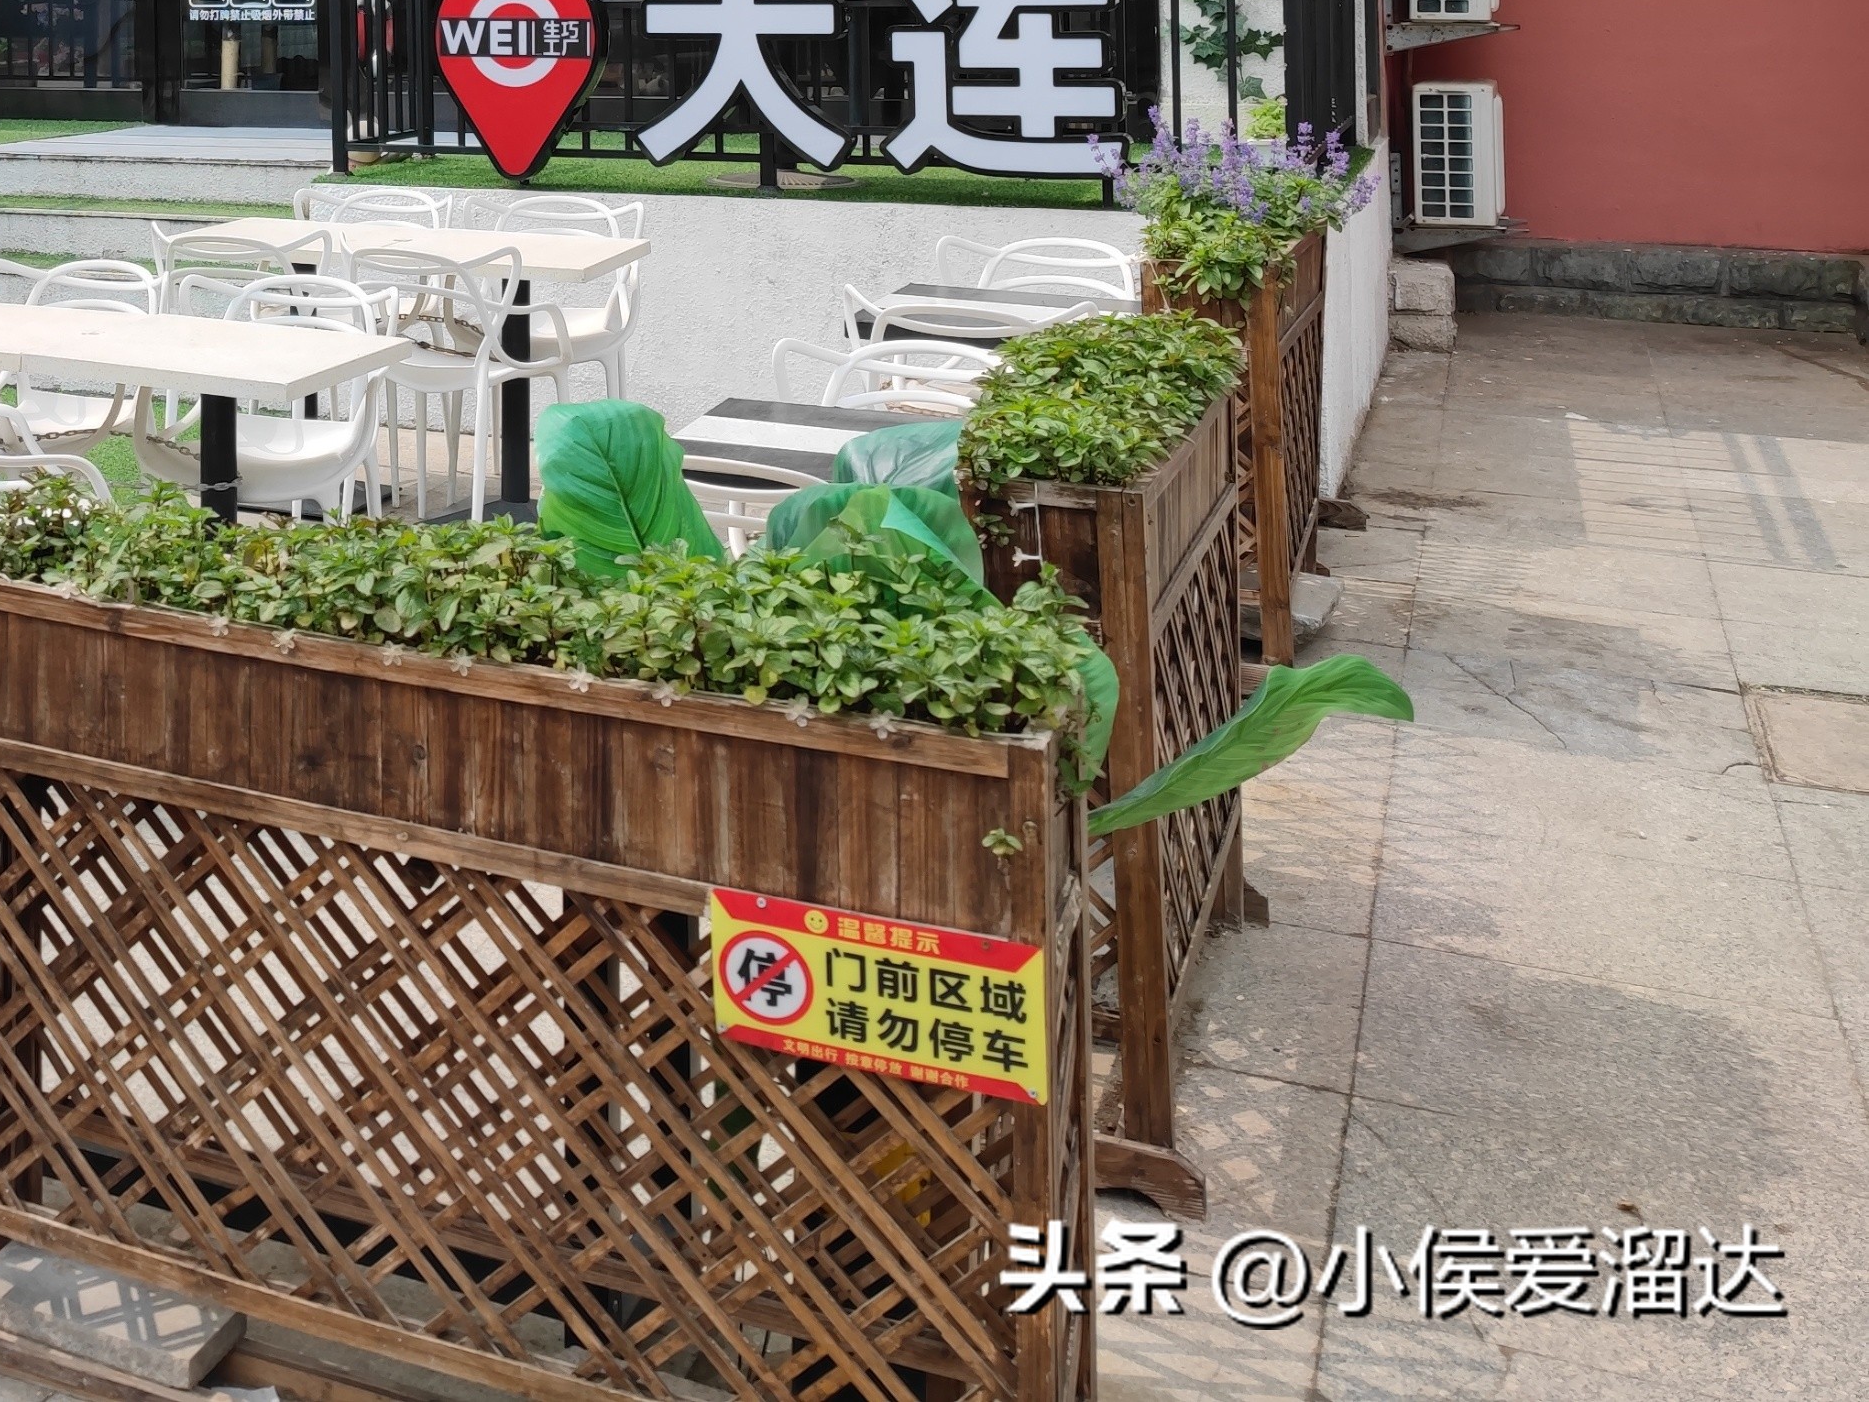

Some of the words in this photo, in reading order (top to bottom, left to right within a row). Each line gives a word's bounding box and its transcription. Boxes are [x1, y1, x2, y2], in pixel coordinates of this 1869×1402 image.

[189, 9, 229, 21] 请勿打牌
[230, 9, 272, 21] 禁止吸烟
[272, 8, 316, 21] 外带禁止
[542, 19, 580, 40] 生巧
[441, 20, 528, 56] WEI
[542, 38, 580, 57] 工厂
[837, 915, 942, 956] 温馨提示
[737, 947, 792, 1007] 停
[825, 948, 1028, 1024] 门前区域
[825, 997, 1029, 1073] 请勿停车
[782, 1038, 839, 1064] 文明出行
[910, 1066, 970, 1090] 谢谢合作
